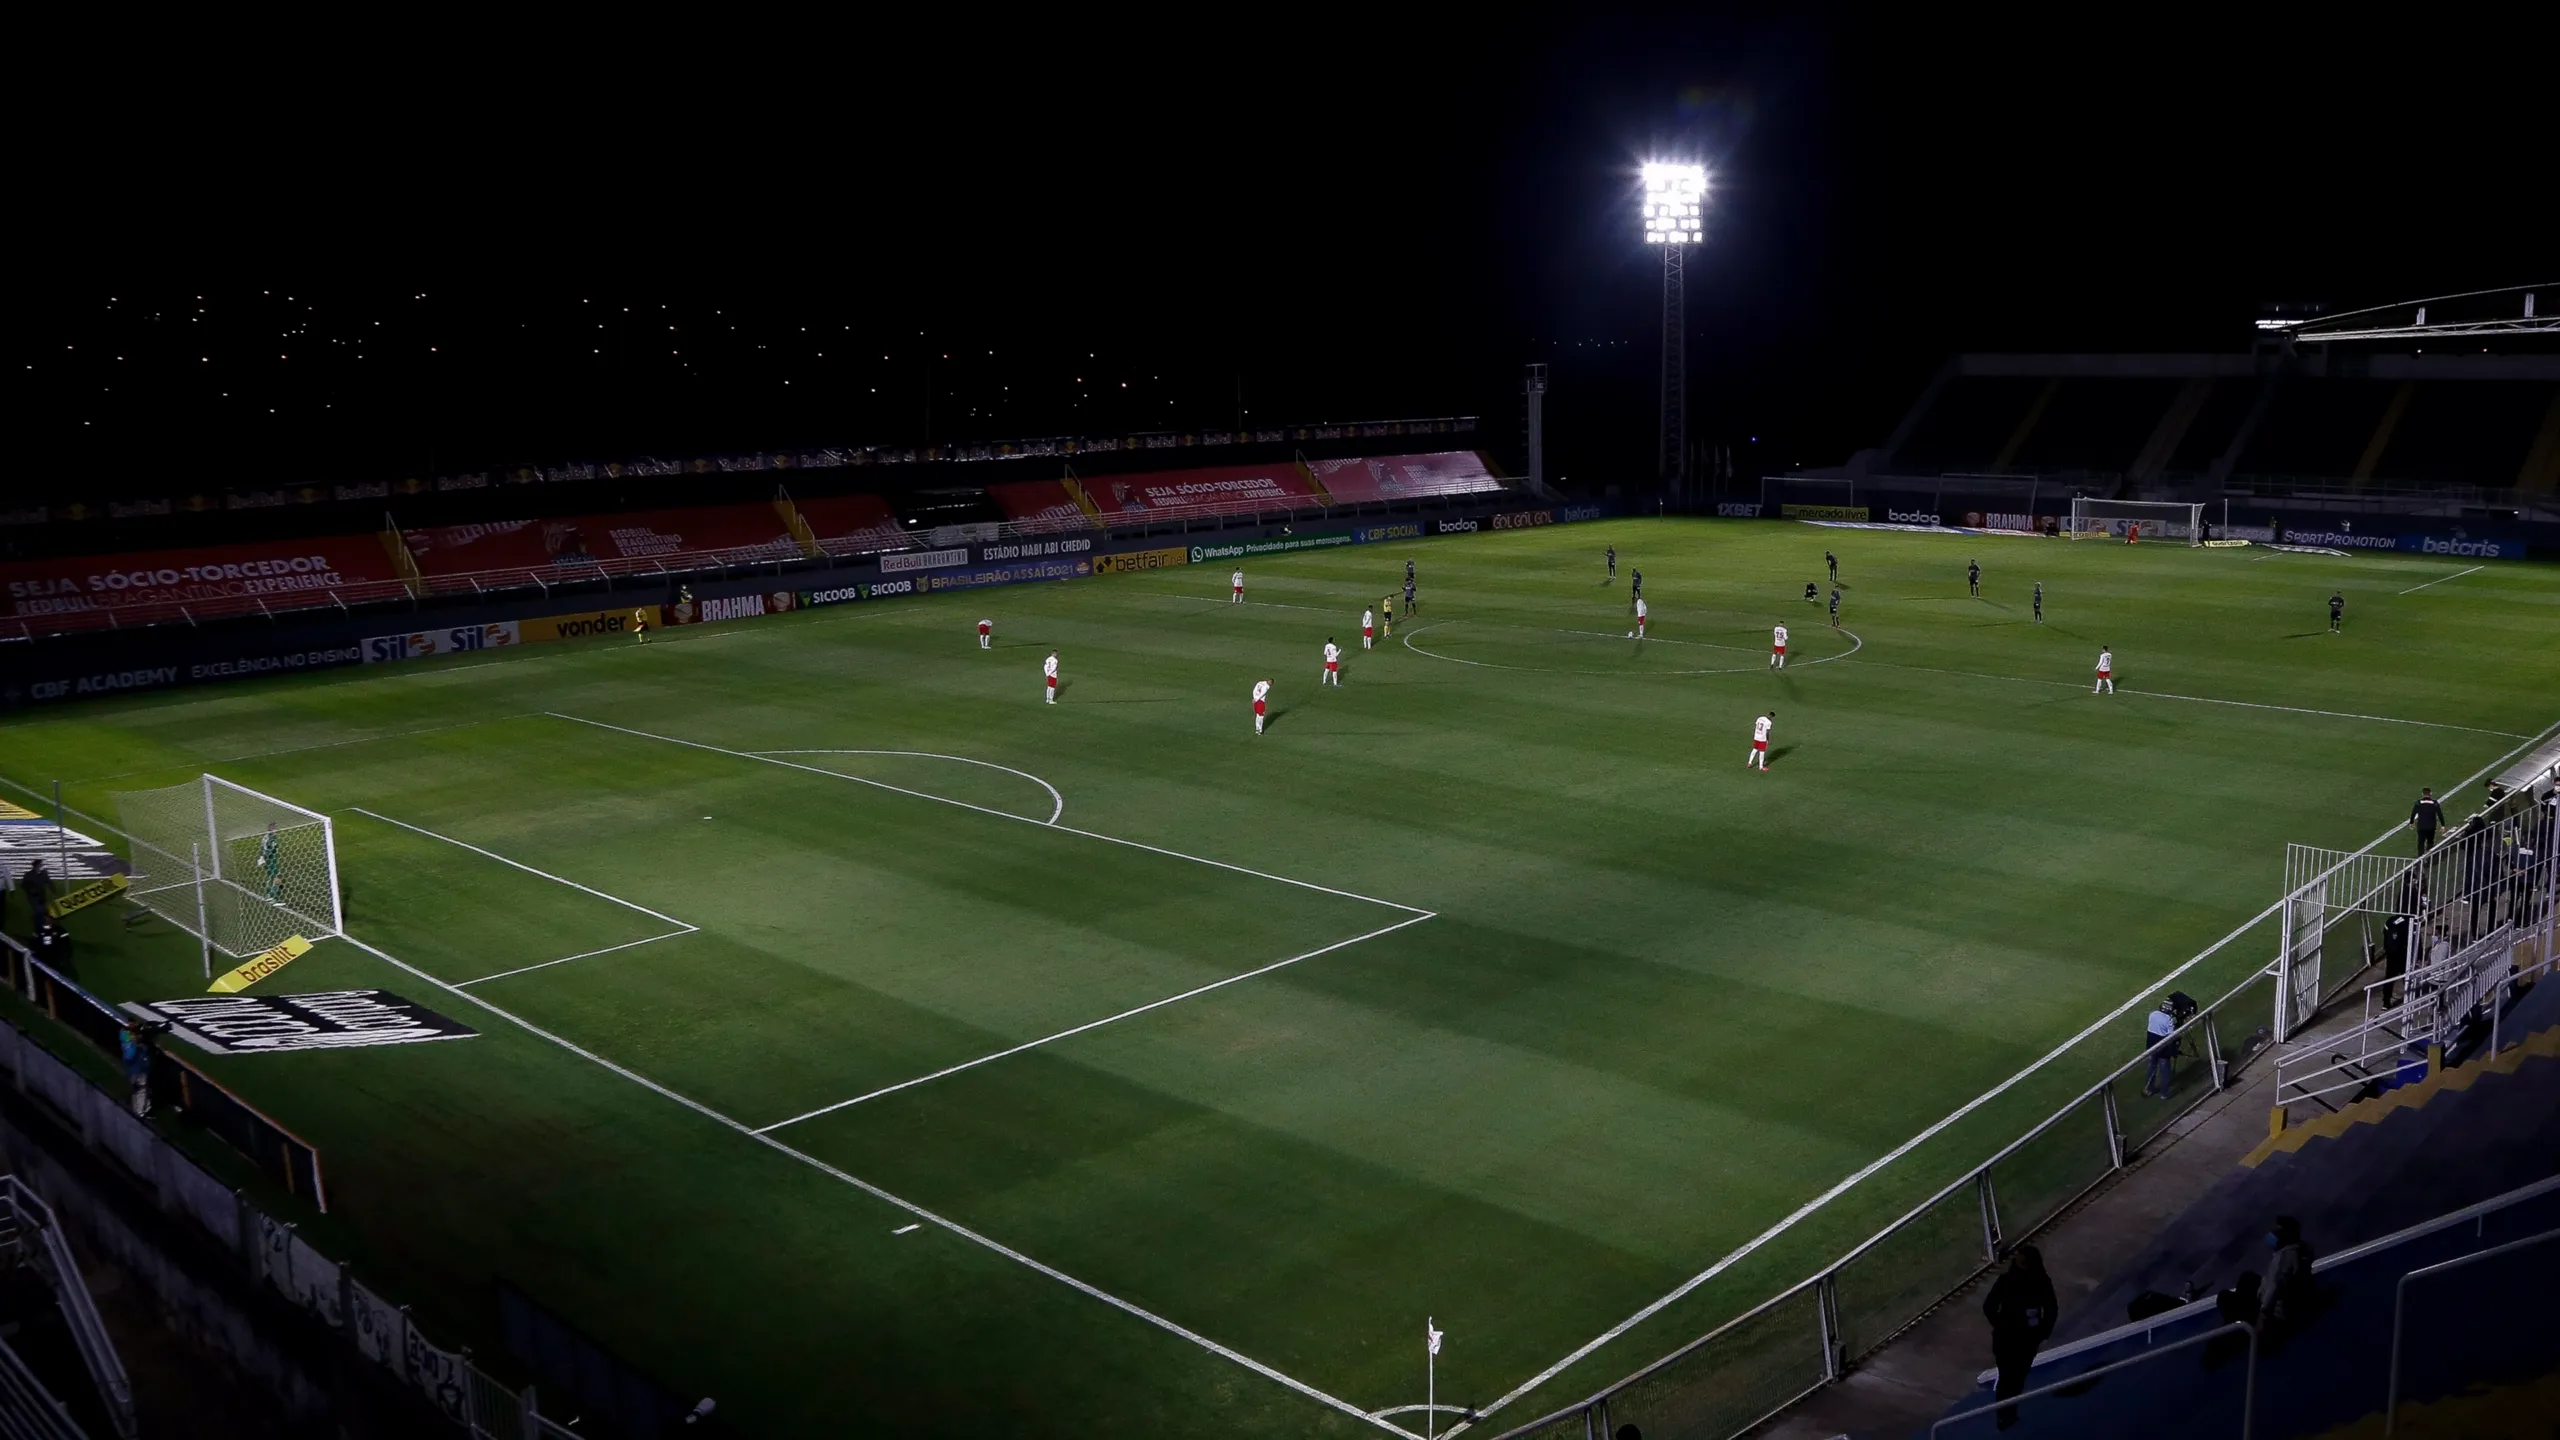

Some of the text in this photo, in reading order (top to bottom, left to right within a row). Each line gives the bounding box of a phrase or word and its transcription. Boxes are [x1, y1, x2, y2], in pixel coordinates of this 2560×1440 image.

[1145, 486, 1176, 498] SEJA
[1717, 502, 1763, 517] 1XBET
[1800, 508, 1867, 520] mercado livre
[1888, 508, 1940, 525] bodog
[1439, 517, 1478, 532] bodog
[1493, 511, 1553, 530] GOL GOL GOL
[1986, 512, 2034, 531] BRAHMA
[1368, 524, 1420, 541] CBF SOCIAL
[984, 539, 1091, 560] ESTÁDIO NABI ABI CHEDID
[1205, 545, 1244, 558] WhatsApp
[1246, 541, 1284, 553] Privacidade
[1284, 539, 1300, 550] para
[1300, 537, 1315, 547] suas
[2421, 536, 2500, 558] betcris
[8, 556, 332, 598] SEJA SÓCIO-TORCEDOR
[931, 569, 1011, 588] BRASILEIRÃO
[1047, 564, 1074, 577] 2021
[813, 580, 912, 604] SICOOB SICOOB
[701, 594, 766, 622] BRAHMA
[557, 613, 627, 638] vonder
[372, 626, 484, 662] Sil Sil
[191, 647, 361, 679] EXCELÊNCIA NO ENSINO
[30, 666, 179, 699] CBF ACADEMY
[236, 945, 297, 982] brasilit
